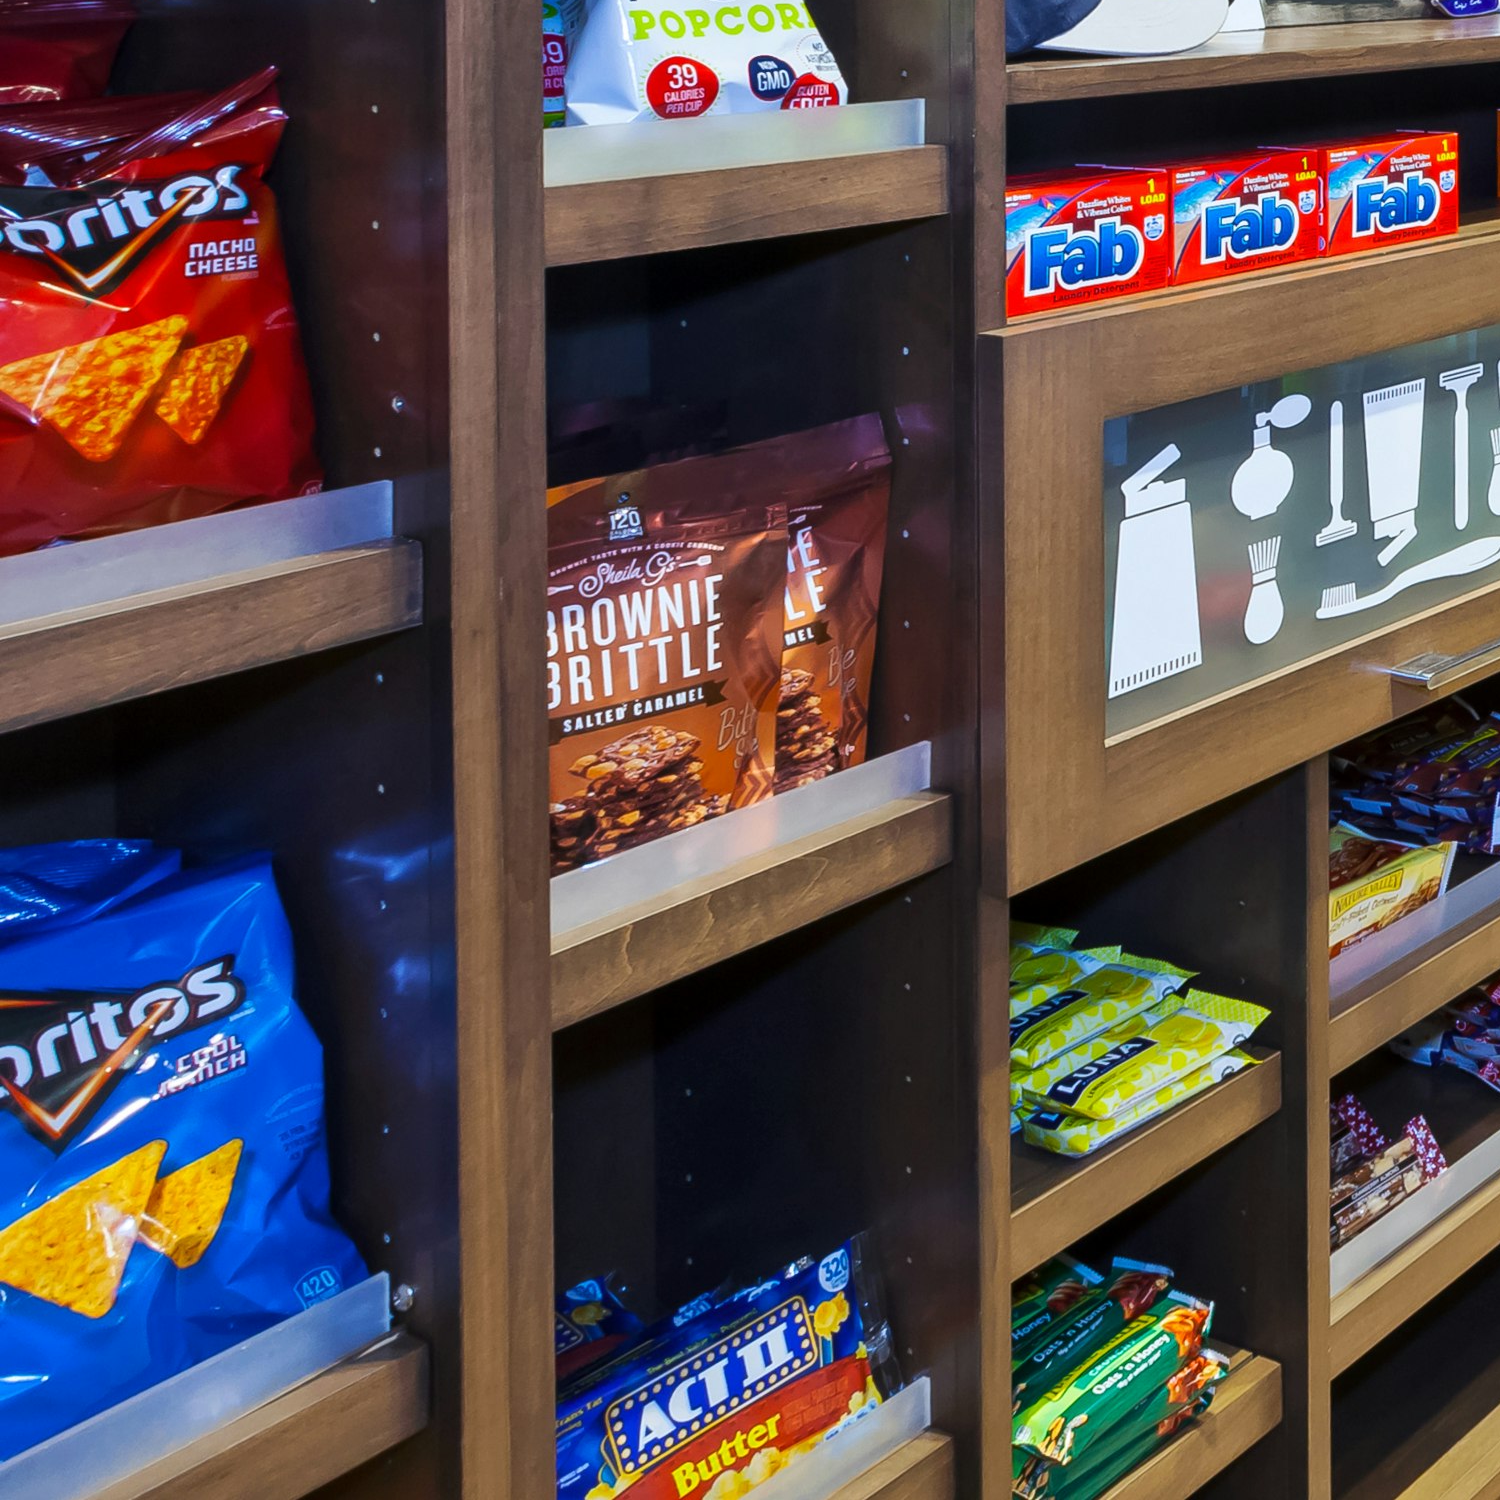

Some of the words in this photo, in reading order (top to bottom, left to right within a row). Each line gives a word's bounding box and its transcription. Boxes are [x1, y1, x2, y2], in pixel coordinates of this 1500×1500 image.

[666, 63, 698, 89] 39
[757, 60, 778, 70] NON
[756, 70, 791, 92] GMO
[797, 83, 830, 98] GLUTEN
[664, 88, 705, 104] CALORIES
[665, 102, 684, 114] PER
[684, 101, 703, 113] CUP
[1436, 151, 1456, 162] LOAD
[1442, 139, 1448, 152] 1
[1269, 172, 1288, 180] Whites
[1295, 171, 1317, 181] LOAD
[1301, 156, 1308, 170] 1
[1140, 192, 1165, 205] LOAD
[1147, 178, 1155, 193] 1
[1270, 181, 1290, 190] Colors
[0, 165, 249, 254] oritos
[1077, 200, 1107, 209] Dazzling
[1108, 196, 1131, 204] Whites
[1084, 207, 1111, 218] Vibrant
[1111, 204, 1133, 214] Colors
[1354, 173, 1438, 236] Fab
[1203, 194, 1297, 262] Fab
[189, 238, 256, 259] NACHO
[1026, 219, 1141, 293] Fab
[184, 254, 259, 277] CHEESE
[1094, 281, 1140, 296] Detergent
[610, 510, 641, 530] 120
[591, 550, 618, 562] TASTE
[578, 558, 645, 598] Sheila
[547, 575, 723, 658] BROWNIE
[547, 623, 723, 710] BRITTLE
[563, 704, 625, 733] SALTED
[633, 687, 705, 716] CARAMEL
[1334, 886, 1368, 918] NATURE
[1370, 873, 1400, 893] VALLEY
[1010, 994, 1073, 1037] UNA
[0, 961, 237, 1099] oritos
[176, 1035, 243, 1073] COOL
[1057, 1042, 1143, 1095] LUNA
[821, 1248, 848, 1282] 320
[301, 1269, 336, 1297] 420
[1011, 1312, 1051, 1341] Honey
[1032, 1337, 1061, 1364] Oats
[1077, 1299, 1114, 1330] Honey
[1092, 1371, 1121, 1396] Oats
[1134, 1333, 1171, 1364] Honey
[638, 1358, 729, 1452] ACT
[737, 1322, 794, 1388] II
[671, 1413, 782, 1498] Butter
